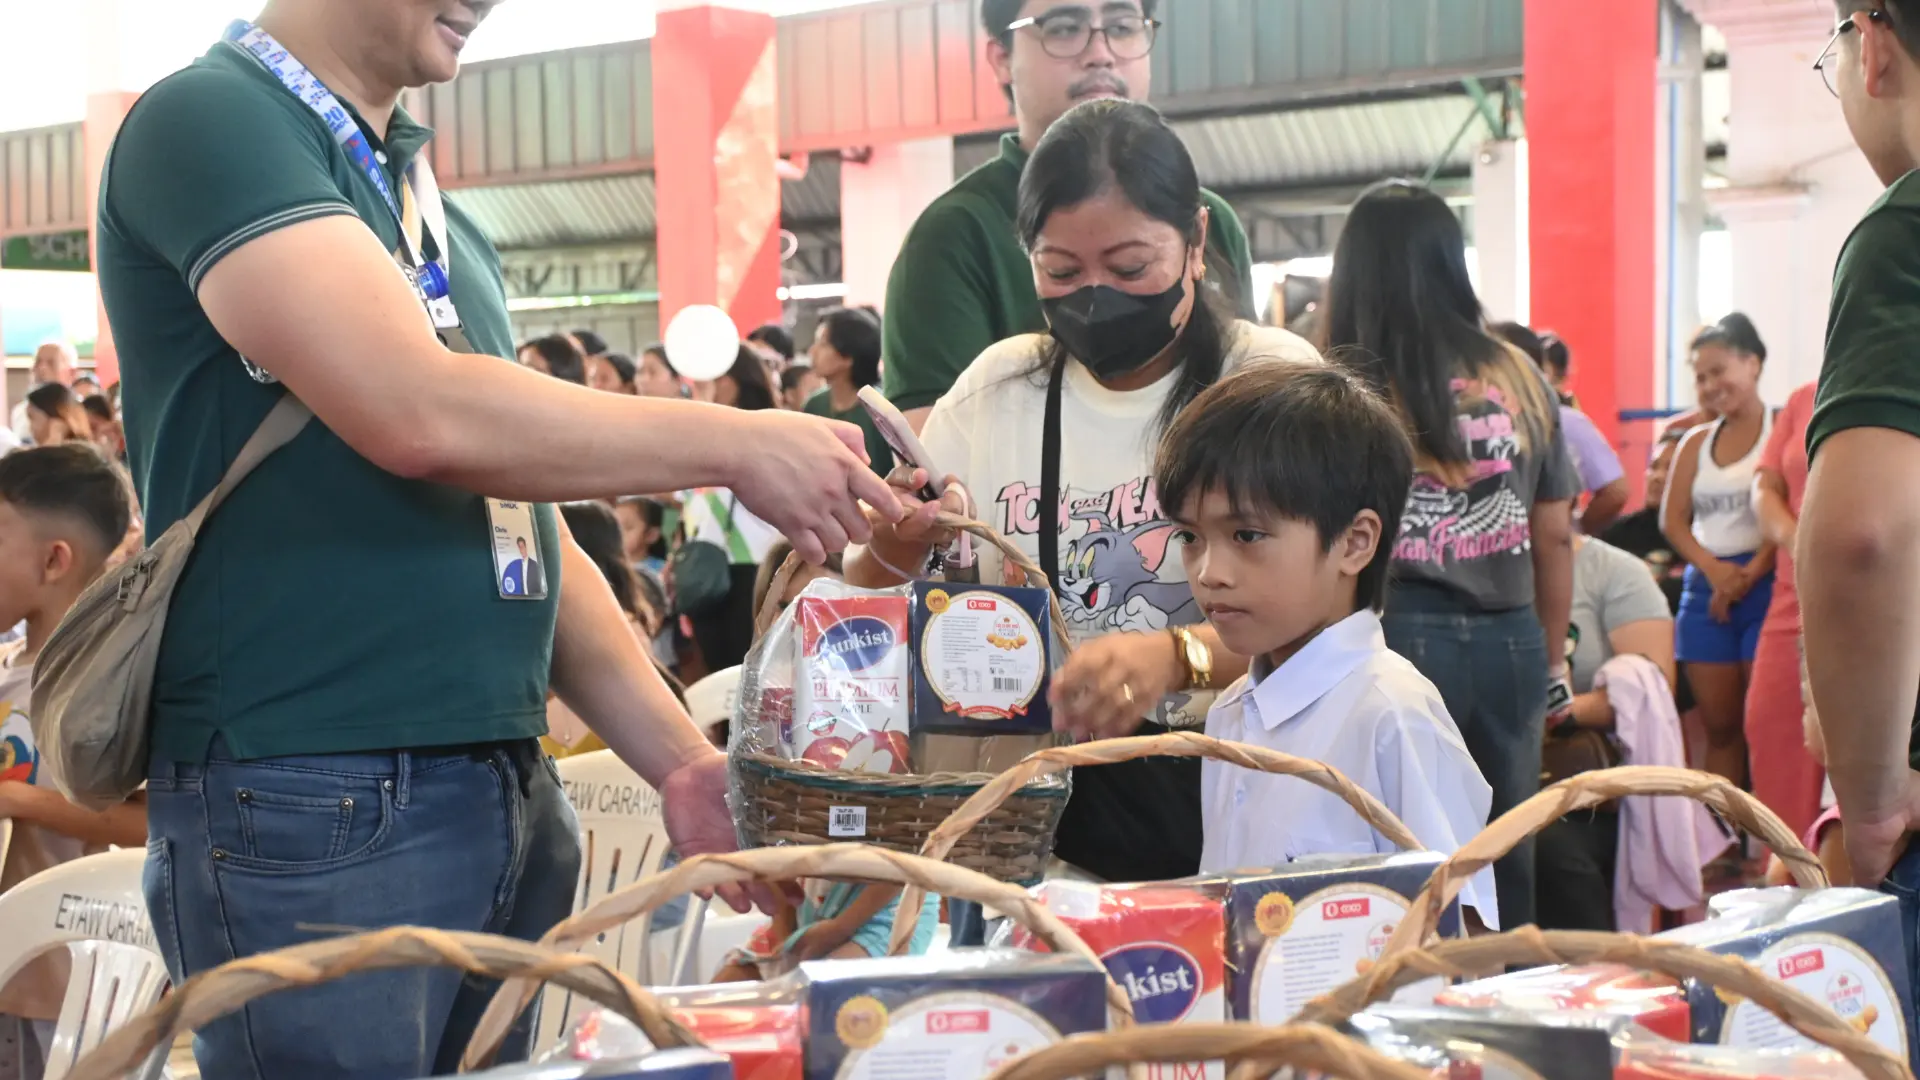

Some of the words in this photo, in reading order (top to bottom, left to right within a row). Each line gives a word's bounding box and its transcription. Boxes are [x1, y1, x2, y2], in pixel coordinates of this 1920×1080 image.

[1104, 475, 1168, 529] JER
[823, 629, 892, 654] unkist
[561, 780, 597, 812] TAW
[599, 784, 661, 816] CARAVA
[55, 893, 107, 936] ETAW
[1123, 964, 1194, 1002] kist
